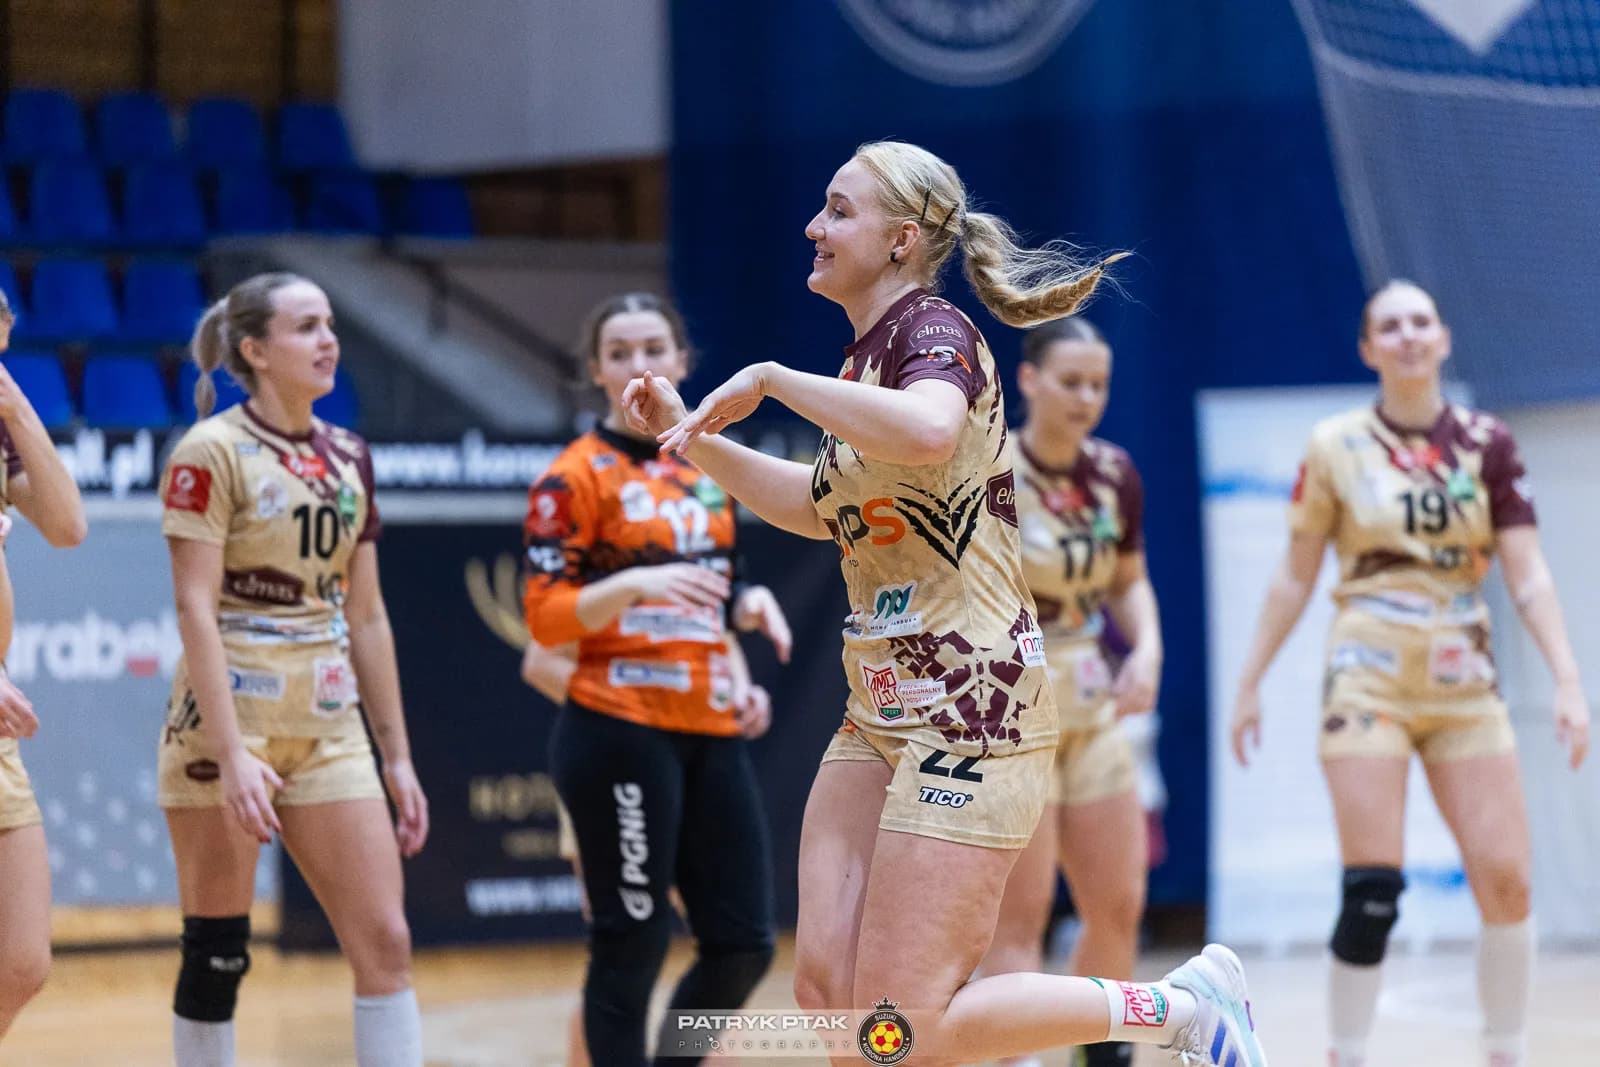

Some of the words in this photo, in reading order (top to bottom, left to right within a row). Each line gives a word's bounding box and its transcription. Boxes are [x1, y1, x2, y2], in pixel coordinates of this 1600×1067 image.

[917, 325, 962, 339] elmas
[293, 505, 339, 560] 10
[659, 496, 715, 553] 12
[1399, 489, 1448, 535] 19
[918, 786, 967, 808] TICO
